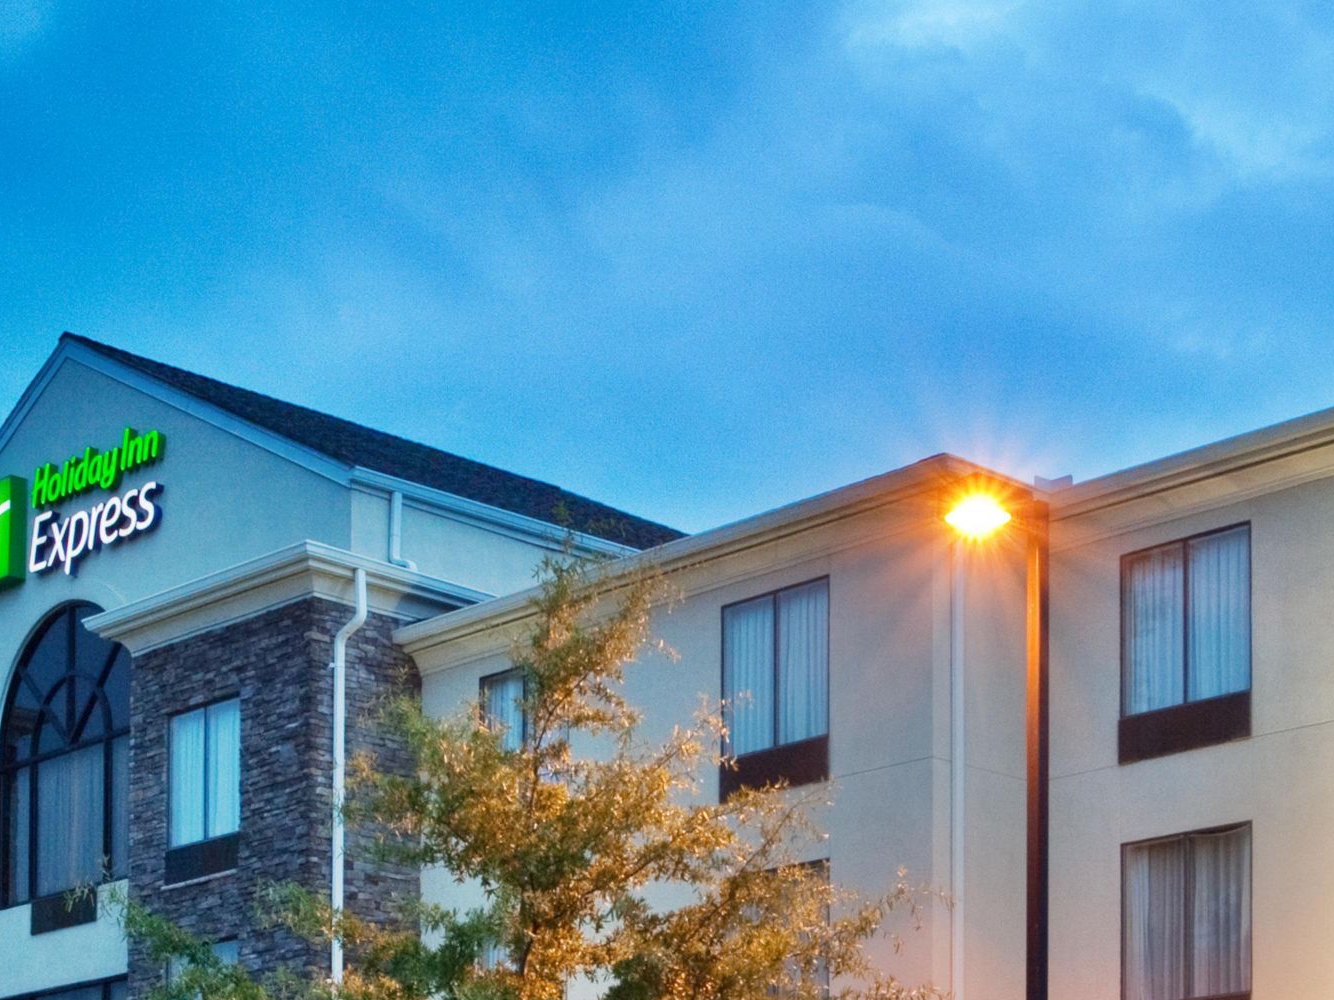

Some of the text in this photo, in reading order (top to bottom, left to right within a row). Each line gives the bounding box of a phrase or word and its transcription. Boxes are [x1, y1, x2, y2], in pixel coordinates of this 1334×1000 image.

[32, 427, 159, 509] Holiday Inn
[28, 481, 157, 575] Express
